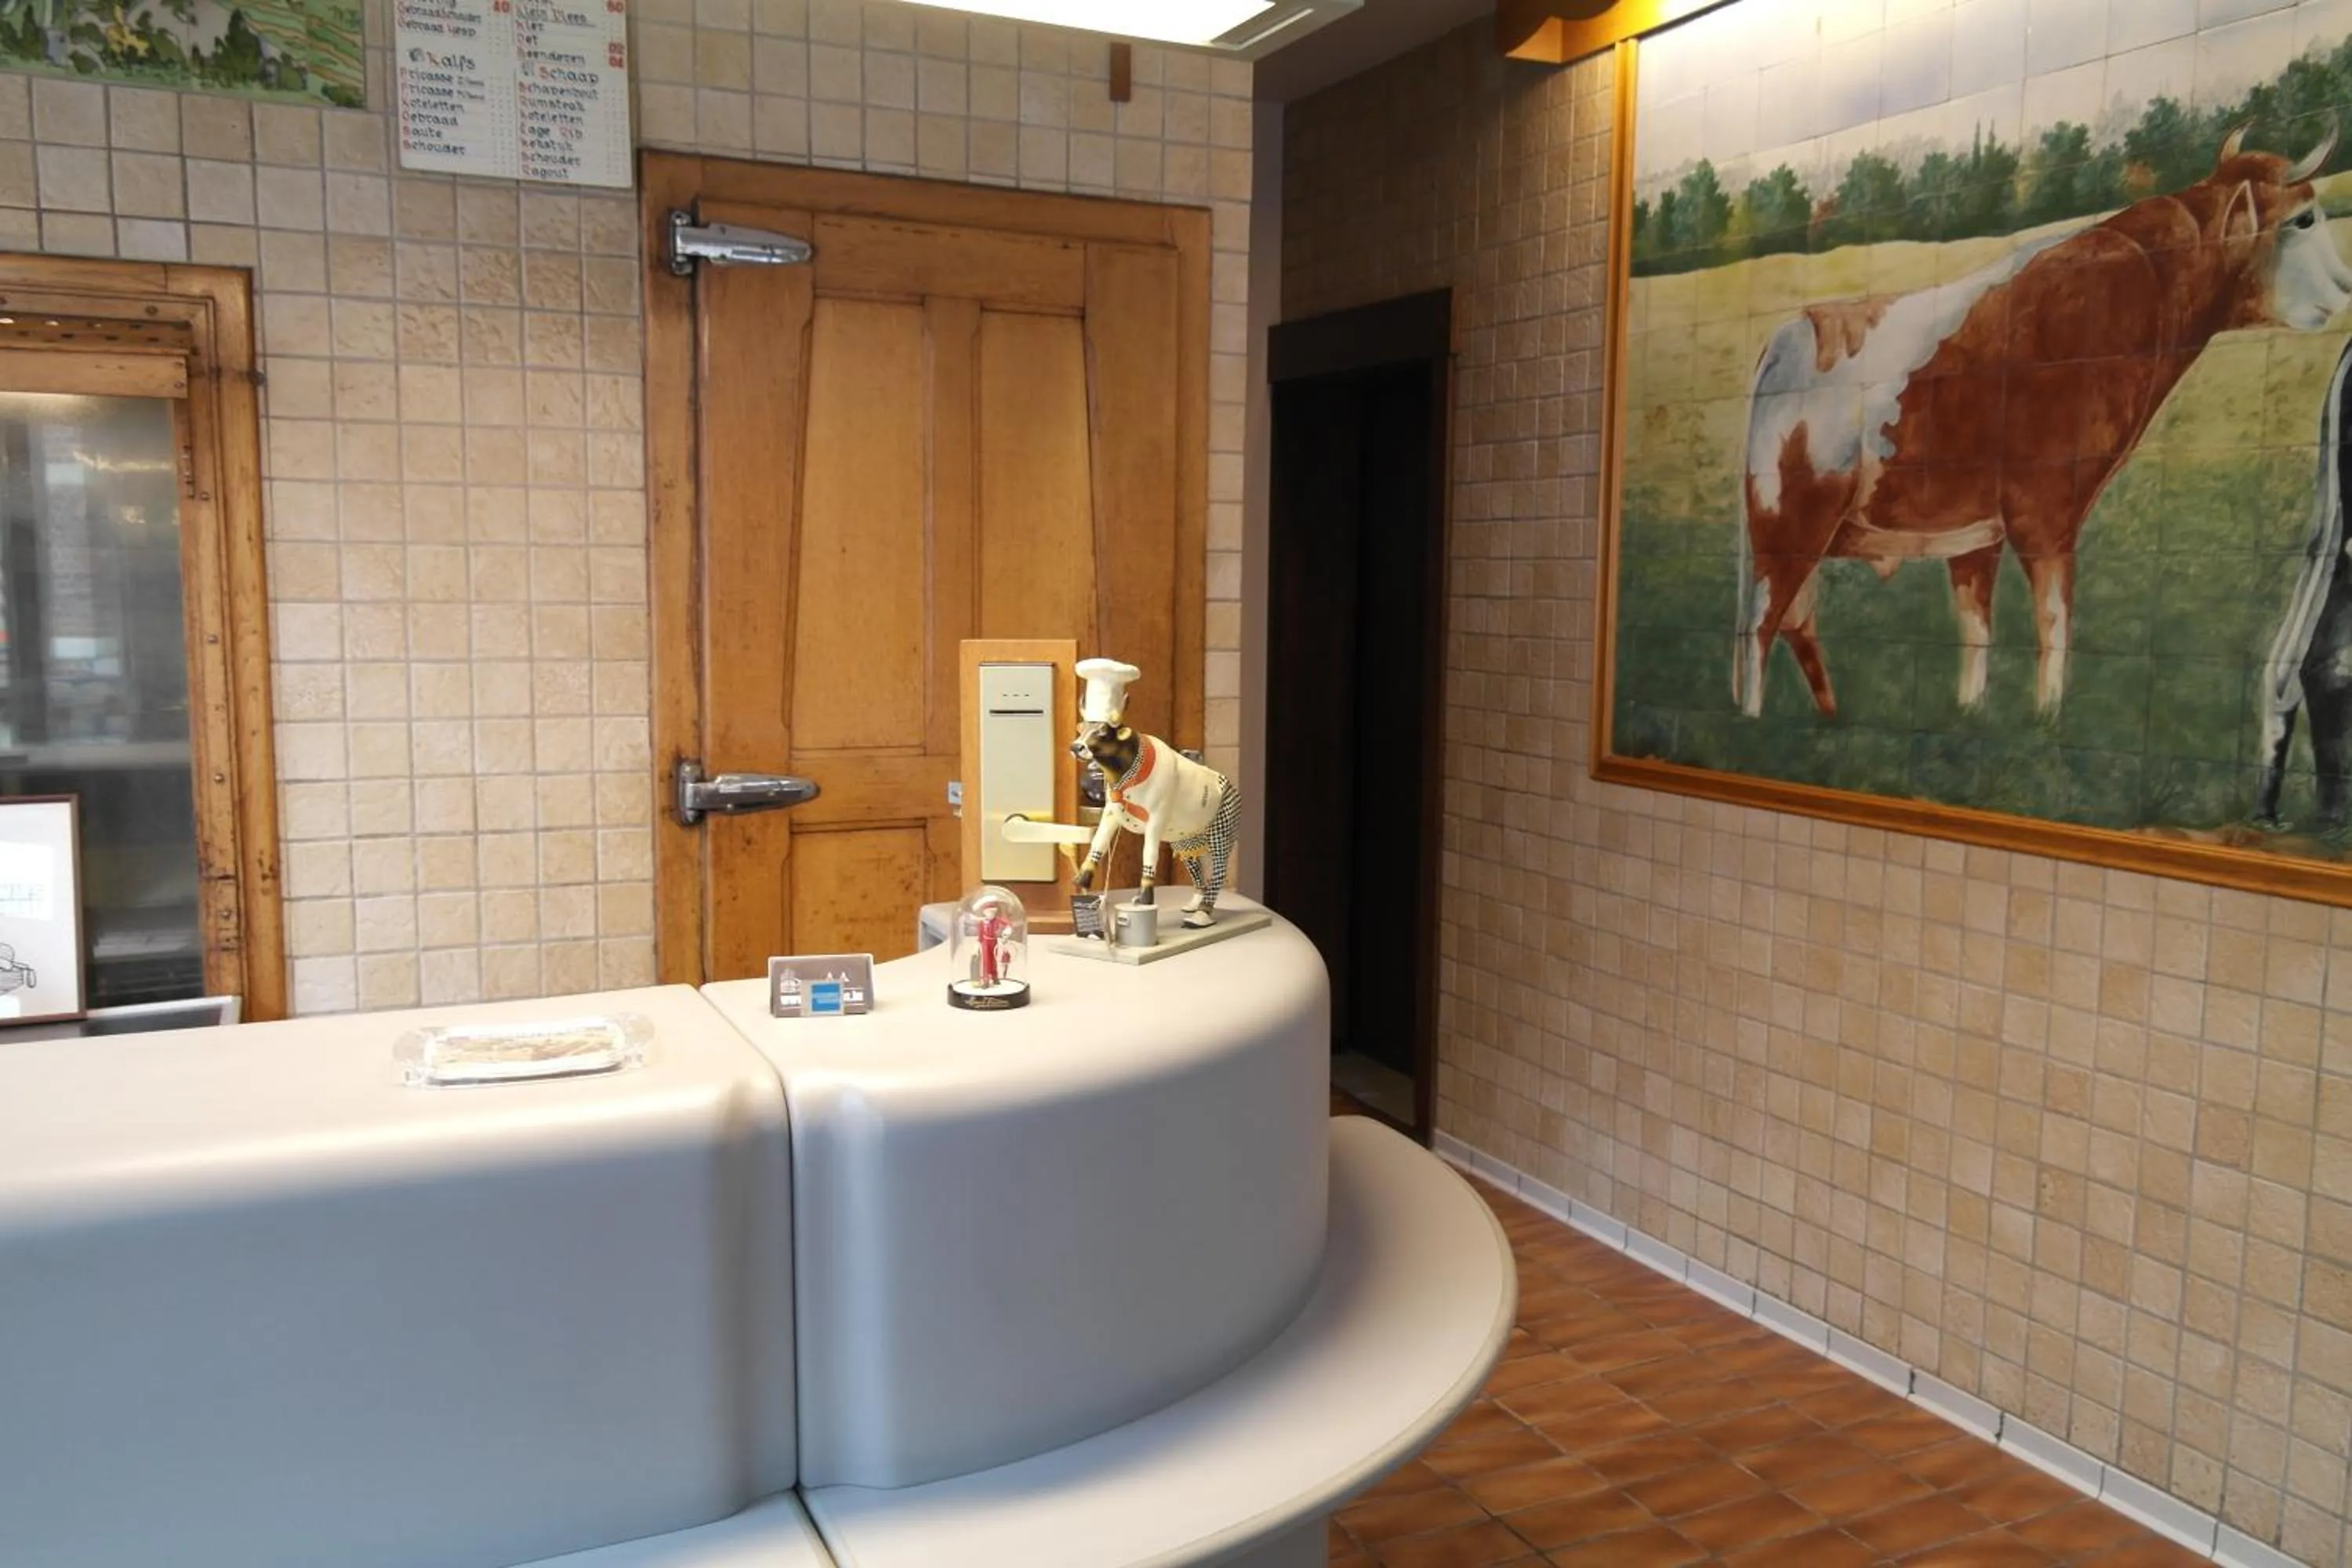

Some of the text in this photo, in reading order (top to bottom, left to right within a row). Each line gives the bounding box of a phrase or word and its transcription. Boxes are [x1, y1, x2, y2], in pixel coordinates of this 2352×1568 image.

[426, 51, 476, 72] Kalfs
[539, 66, 599, 85] Schaap
[402, 139, 466, 155] Schouder
[521, 164, 569, 180] Ragout
